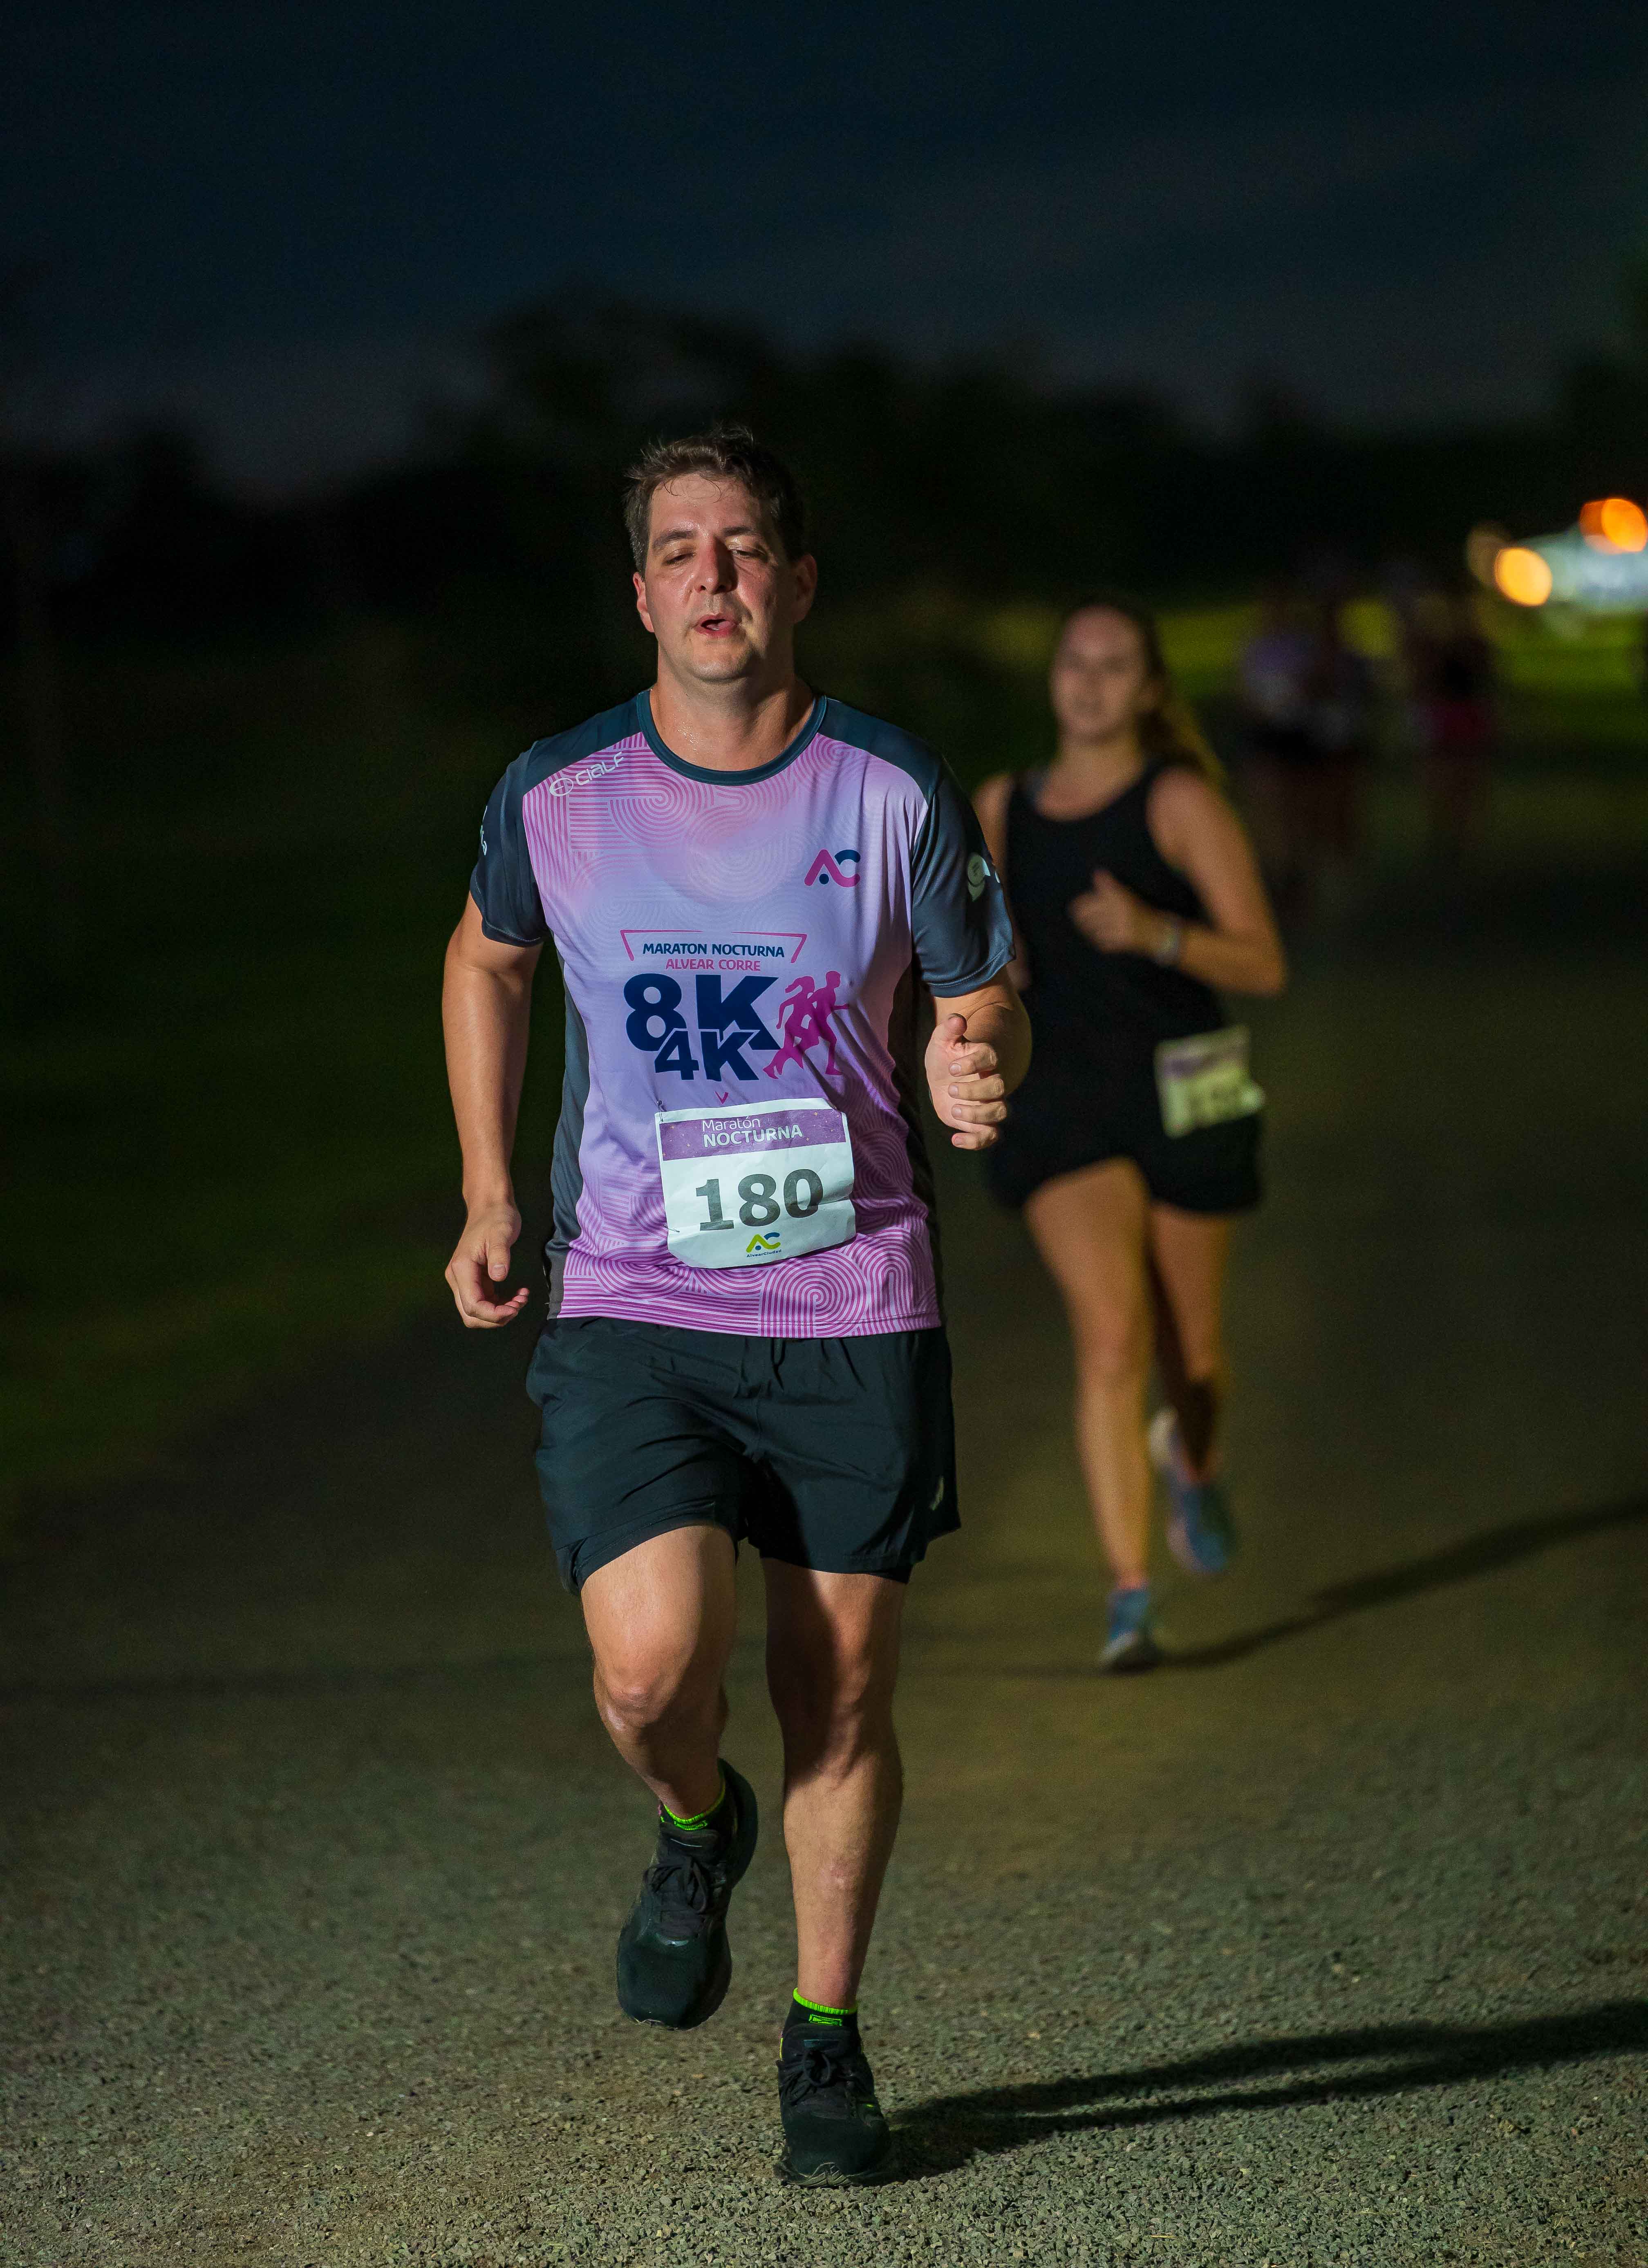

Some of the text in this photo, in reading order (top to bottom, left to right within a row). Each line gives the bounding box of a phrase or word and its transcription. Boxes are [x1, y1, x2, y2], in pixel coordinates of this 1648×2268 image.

[643, 943, 784, 957] MARATON NOCTURNA
[665, 958, 761, 971] ALVEAR CORRE
[623, 973, 782, 1052] 8K
[654, 1030, 759, 1082] 4K
[702, 1116, 761, 1132] Maratón
[703, 1125, 803, 1147] NOCTURNA
[696, 1169, 824, 1231] 180
[746, 1249, 782, 1258] AlvearCiudad
